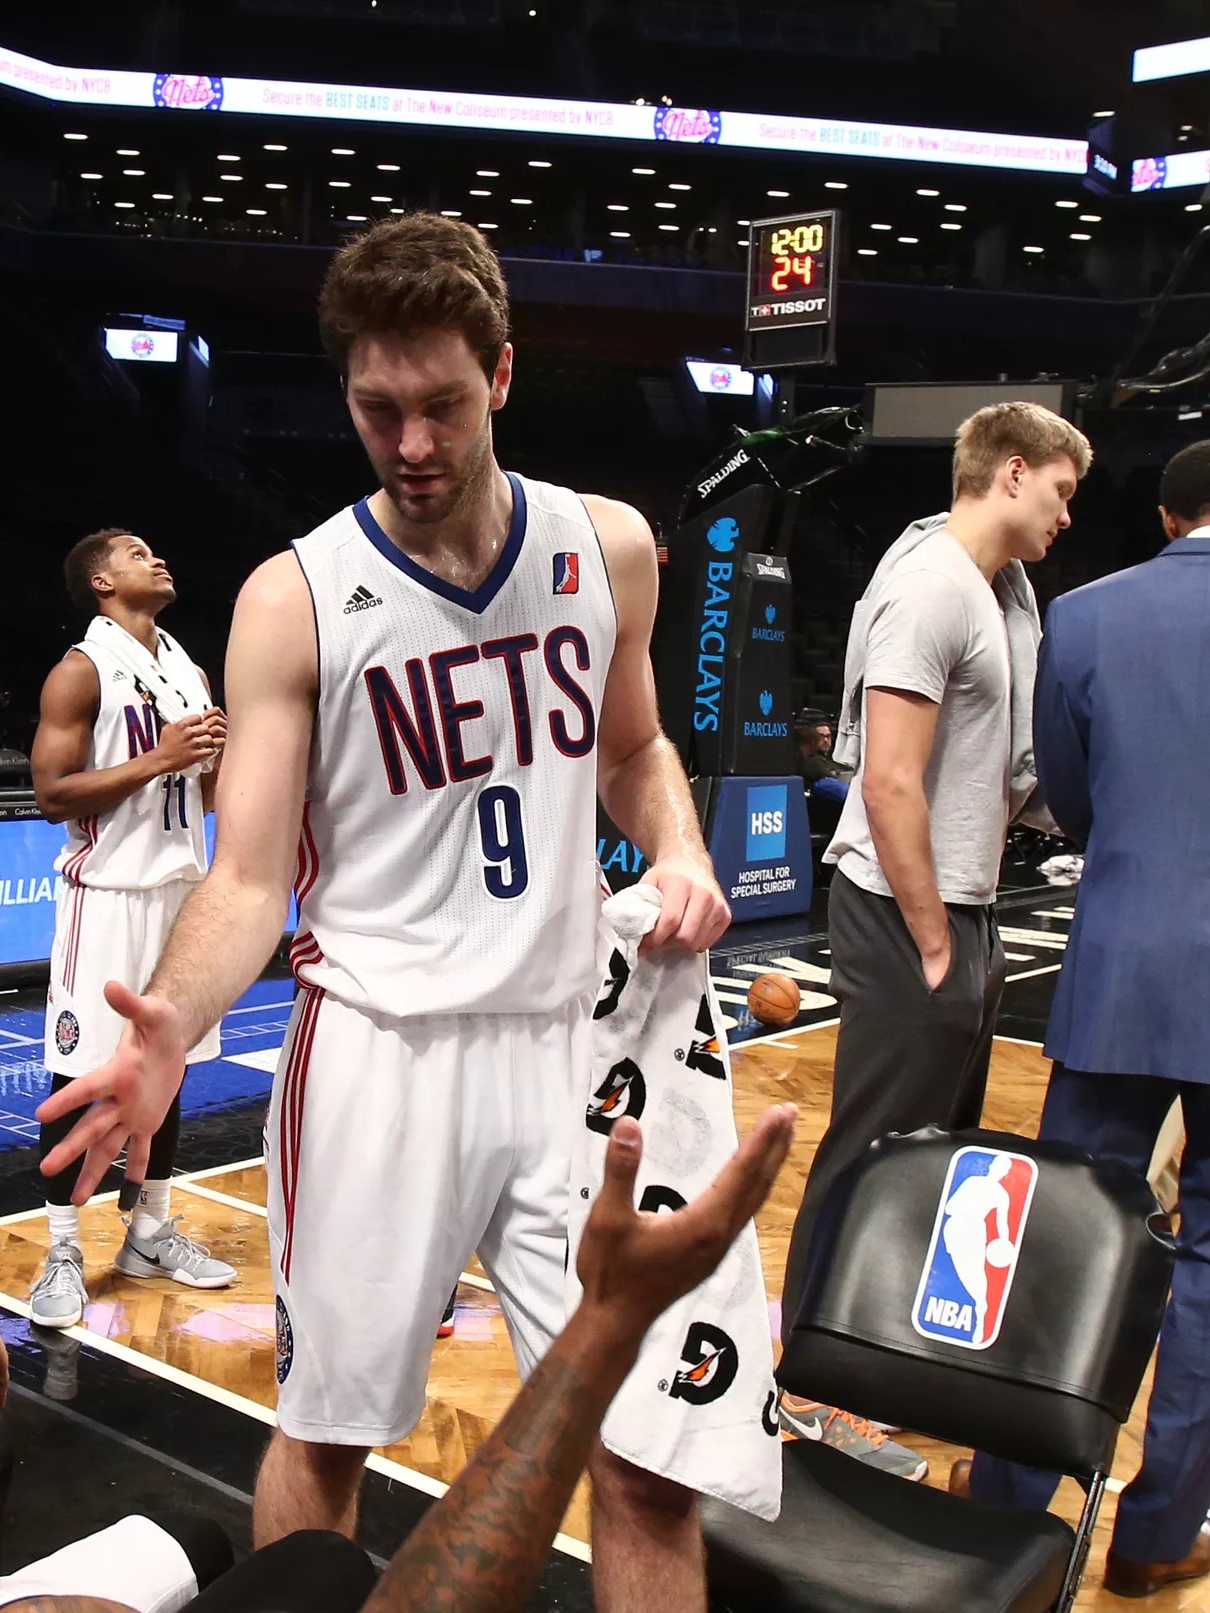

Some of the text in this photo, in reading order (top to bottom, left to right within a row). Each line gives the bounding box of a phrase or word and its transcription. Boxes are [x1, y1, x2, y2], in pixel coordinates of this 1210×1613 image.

[162, 76, 215, 106] Nets
[262, 88, 613, 126] Secure the BEST SEATS at The New Coliseum presented by NYCB
[662, 110, 713, 140] Nets
[759, 123, 797, 140] Secure
[820, 127, 845, 143] BEST
[849, 129, 881, 146] SEATS
[896, 134, 914, 149] The
[917, 135, 938, 151] New
[771, 224, 823, 256] 12:00
[771, 255, 812, 291] 24
[772, 298, 826, 315] TISSOT
[697, 449, 751, 499] SPALDING
[756, 563, 786, 580] SPALDING
[343, 597, 384, 615] adidas
[693, 560, 734, 732] BARCLAYS
[752, 627, 785, 642] BARCLAYS
[364, 625, 595, 795] NETS
[744, 722, 788, 737] BARCLAYS
[162, 774, 189, 832] 11
[751, 811, 783, 836] HSS
[477, 783, 528, 899] 9
[731, 878, 797, 899] SPECIAL SURGERY
[738, 866, 790, 884] HOSPITAL FOR
[924, 1296, 973, 1332] NBA
